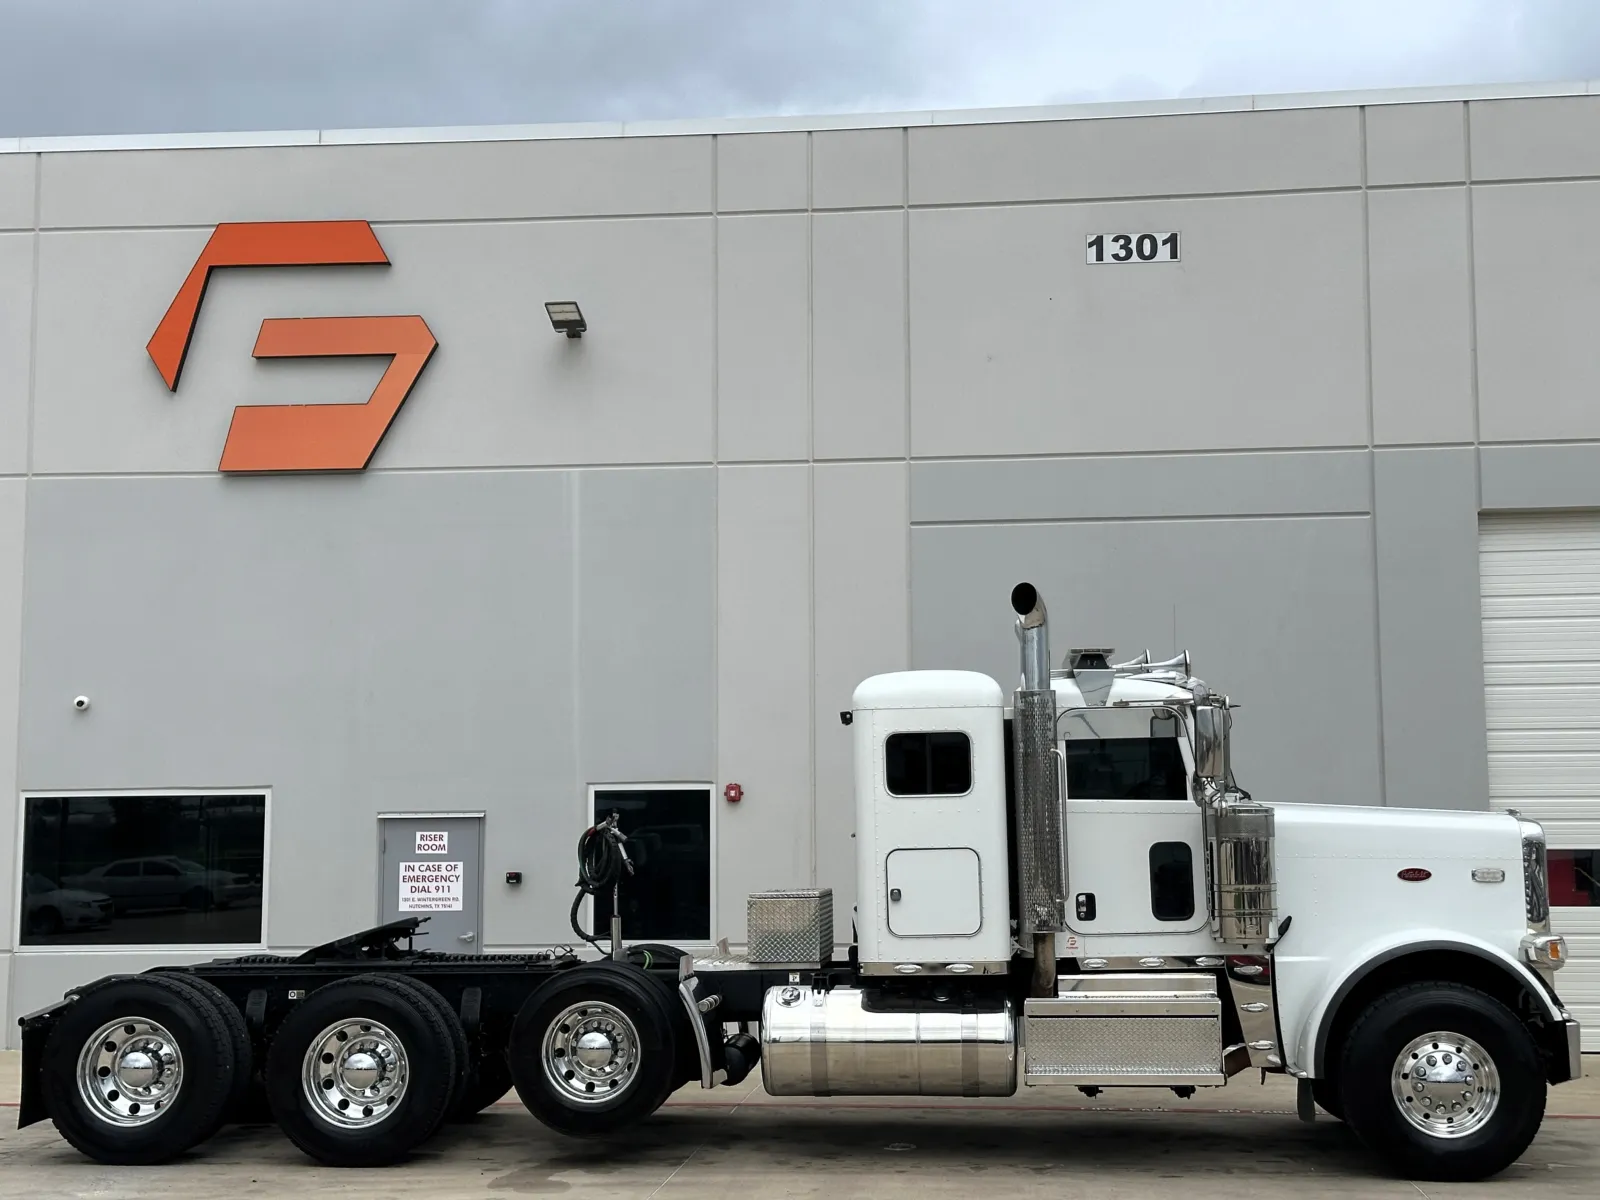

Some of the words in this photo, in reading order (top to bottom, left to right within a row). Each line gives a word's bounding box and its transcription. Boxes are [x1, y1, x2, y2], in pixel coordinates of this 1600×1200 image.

[1088, 232, 1178, 262] 1301
[420, 834, 444, 842] RISER
[417, 843, 446, 851] ROOM
[404, 864, 415, 872] IN
[418, 864, 442, 872] CASE
[445, 864, 459, 872] OF
[402, 875, 460, 883] EMERGENCY
[410, 885, 432, 893] DIAL
[434, 885, 451, 893] 911
